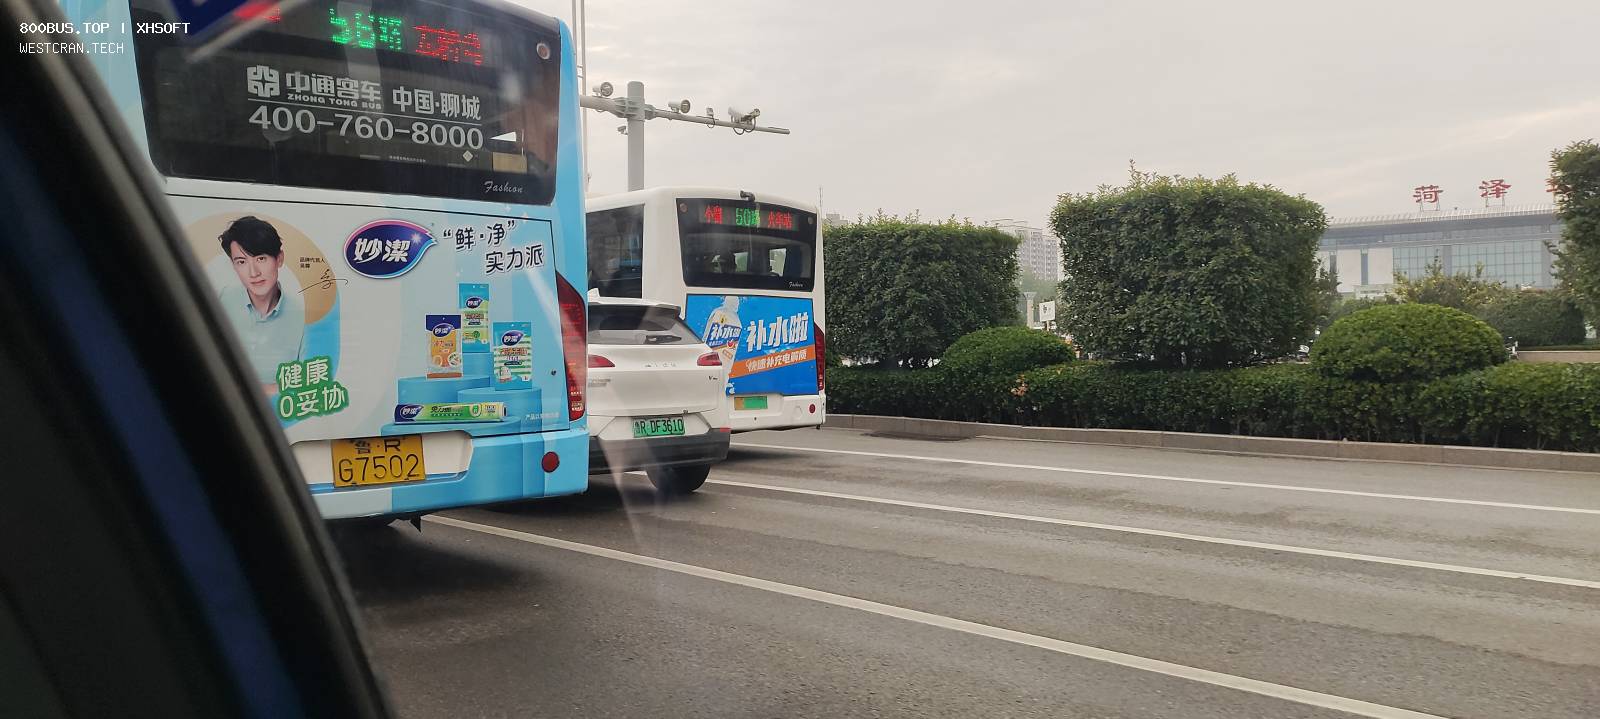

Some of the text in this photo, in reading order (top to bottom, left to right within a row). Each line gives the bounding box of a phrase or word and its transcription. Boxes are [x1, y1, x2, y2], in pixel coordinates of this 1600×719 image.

[285, 72, 482, 121] 中通客车 中国·聊城
[287, 93, 326, 105] ZHONG
[329, 98, 358, 108] TONG
[248, 105, 484, 149] 400-760-8000
[485, 245, 544, 274] 实力派
[746, 312, 809, 352] 补水啦
[277, 359, 328, 391] 健康
[338, 453, 419, 483] G7502
